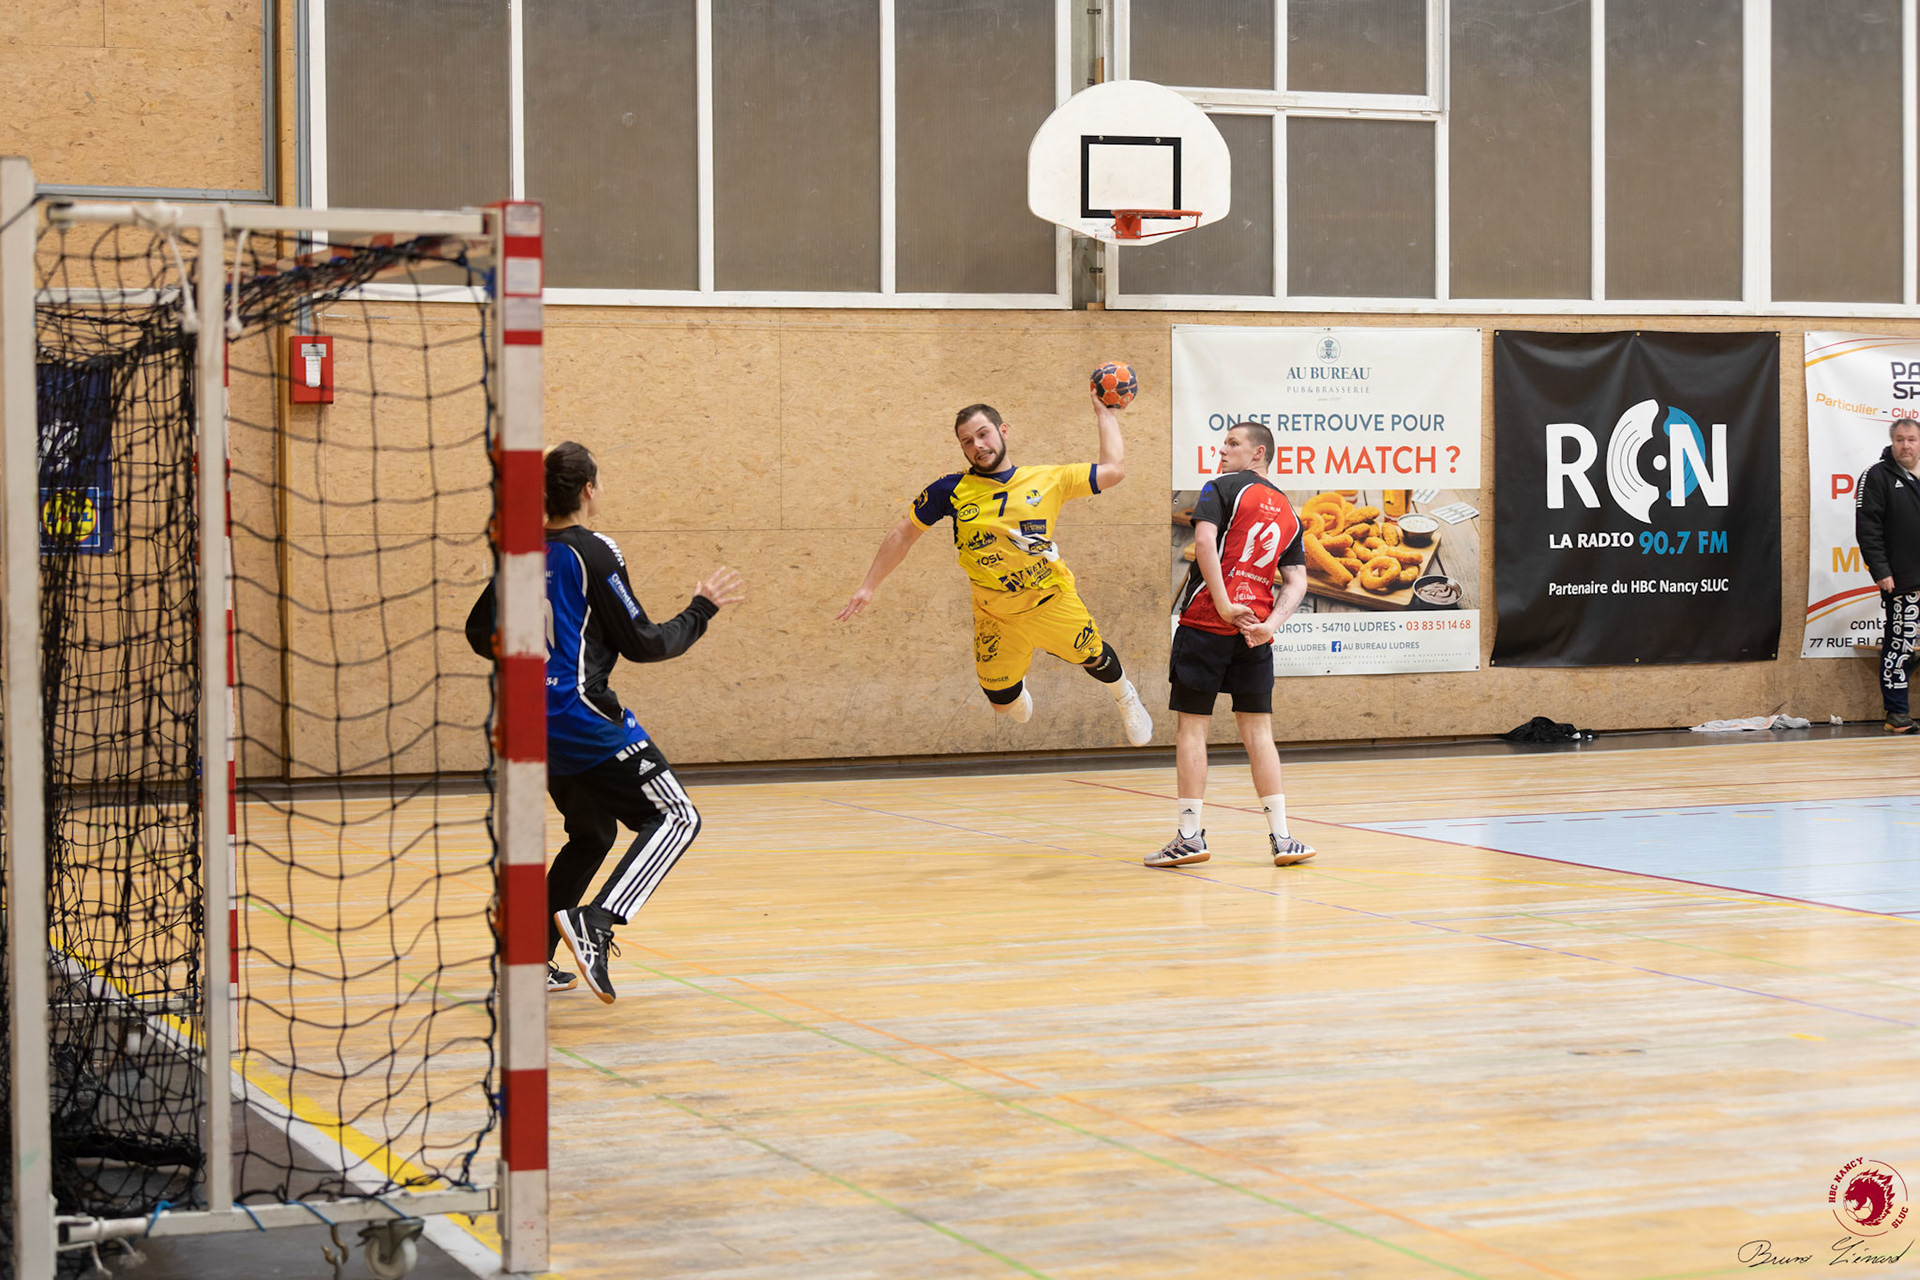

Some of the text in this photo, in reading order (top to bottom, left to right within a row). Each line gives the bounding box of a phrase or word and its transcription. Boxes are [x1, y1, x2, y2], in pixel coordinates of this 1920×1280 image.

[1286, 366, 1371, 380] AU BUREAU
[1815, 393, 1879, 416] Particulier
[1891, 407, 1919, 420] Club
[1277, 413, 1385, 431] RETROUVE
[1391, 413, 1445, 432] POUR
[1325, 445, 1436, 474] MATCH
[1445, 445, 1461, 474] ?
[958, 506, 978, 518] cora
[992, 491, 1009, 517] 7
[1239, 521, 1281, 569] 19
[1549, 530, 1729, 555] LA RADIO 90.7 FM
[1549, 578, 1729, 596] Partenaire du HBC Nancy SLUC
[1274, 622, 1313, 634] UROTS
[1322, 622, 1351, 633] 54710
[1353, 621, 1396, 632] LUDRES
[1406, 620, 1420, 631] 03
[1421, 620, 1434, 631] 83
[1435, 620, 1446, 630] 51
[1448, 619, 1457, 630] 14
[1459, 619, 1471, 630] 68
[1272, 644, 1327, 652] REAU_LUDRES
[1355, 642, 1388, 650] BUREAU
[1389, 641, 1420, 650] LUDRES
[1809, 638, 1823, 648] 77
[1826, 637, 1853, 648] RUE
[1883, 651, 1898, 689] sport
[545, 677, 558, 686] 54
